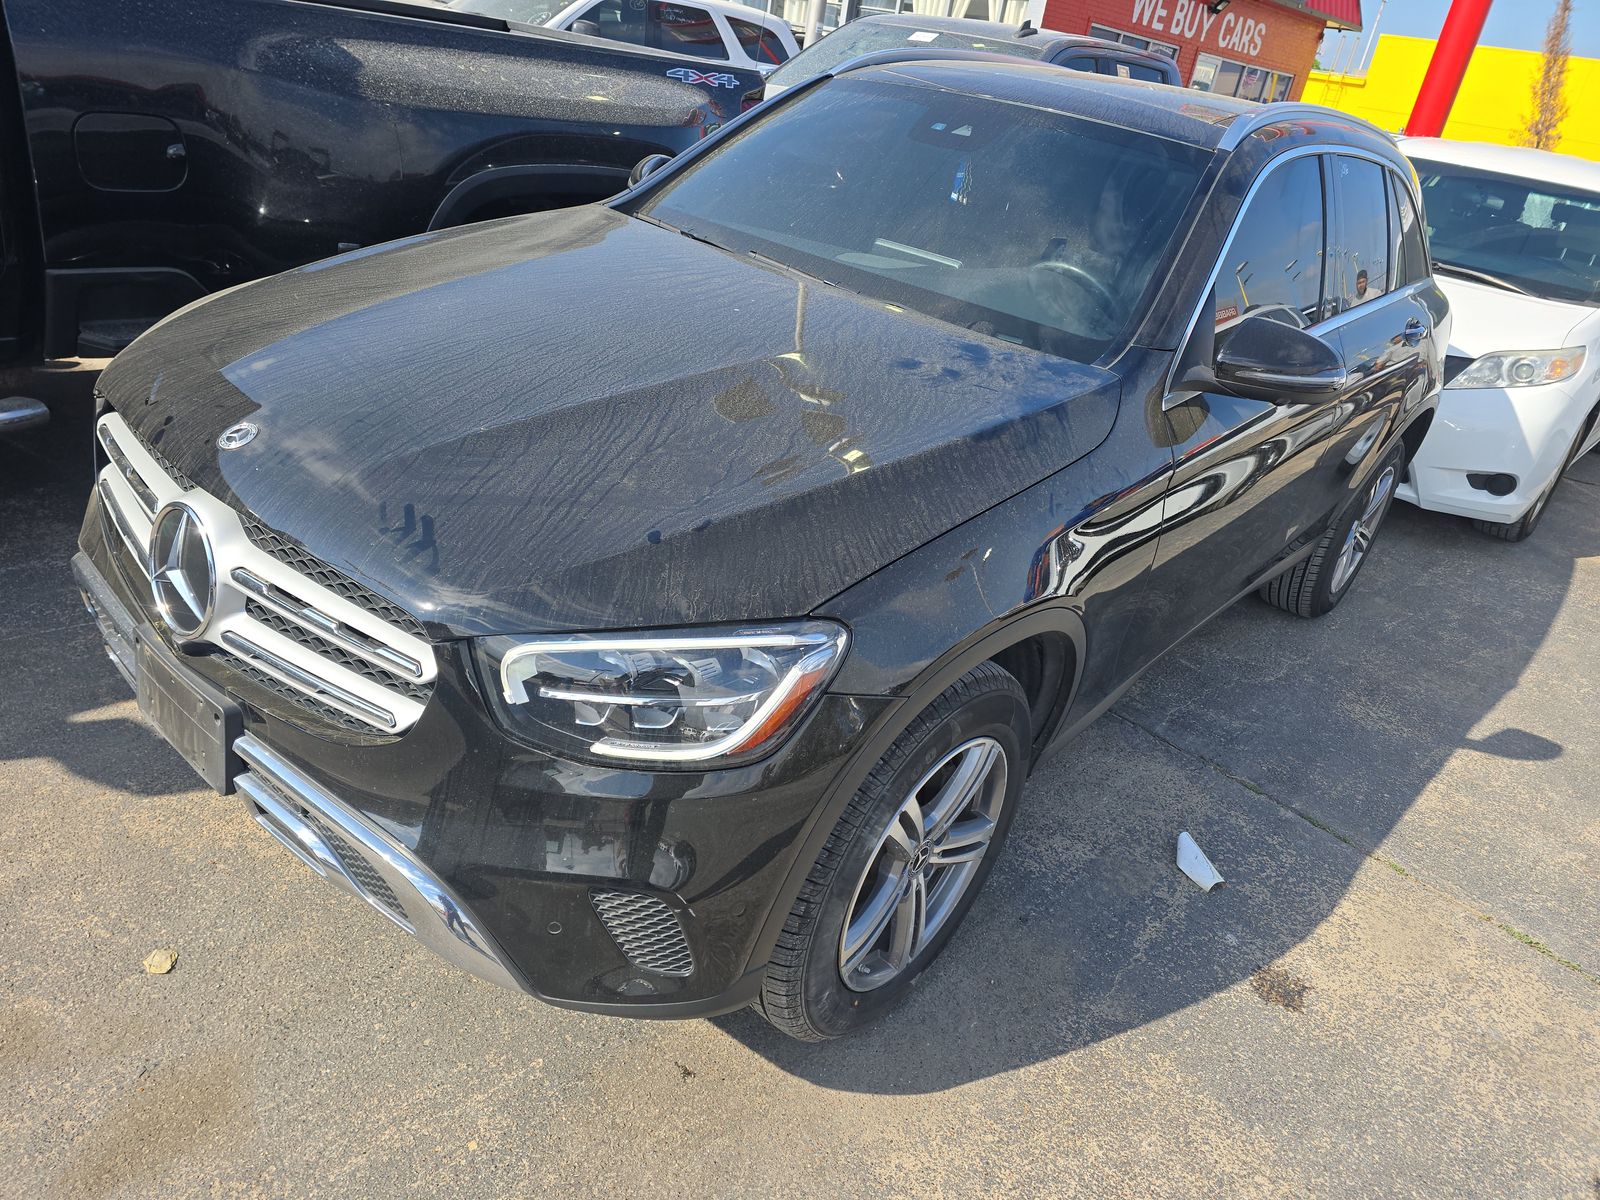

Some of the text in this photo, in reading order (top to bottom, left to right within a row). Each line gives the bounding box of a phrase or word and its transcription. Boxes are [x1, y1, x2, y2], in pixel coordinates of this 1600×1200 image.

[1131, 0, 1266, 56] WE BUY CARS
